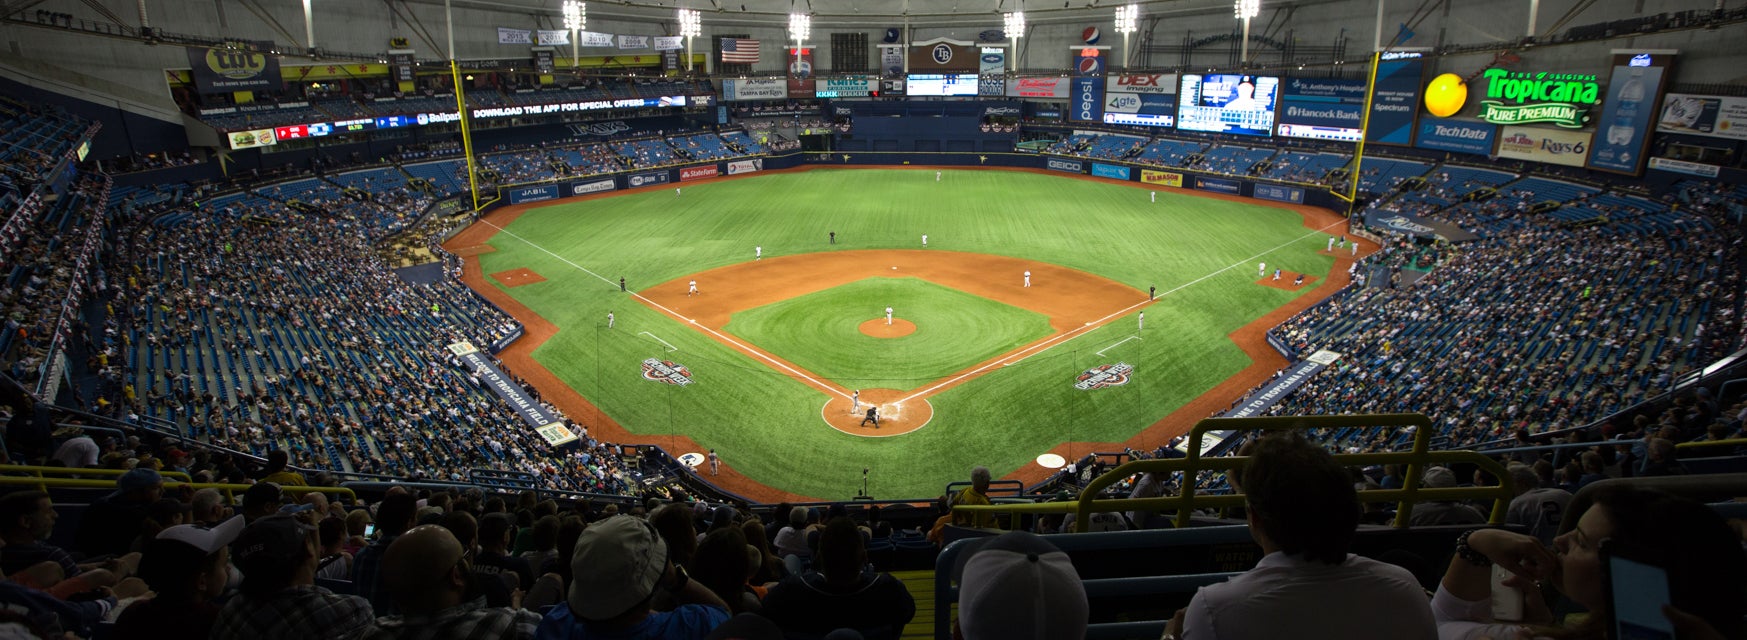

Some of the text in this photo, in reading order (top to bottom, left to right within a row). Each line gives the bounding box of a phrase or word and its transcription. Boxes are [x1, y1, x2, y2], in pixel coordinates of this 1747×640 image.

[1117, 74, 1162, 86] DEX
[1484, 68, 1599, 104] Tropicana
[1081, 80, 1094, 120] pepsi
[1120, 97, 1136, 106] gte
[474, 108, 522, 118] DOWNLOAD
[524, 106, 542, 114] THE
[543, 104, 560, 113] APP
[562, 103, 579, 111] FOR
[580, 101, 614, 110] SPECIAL
[614, 99, 644, 107] OFFERS
[1298, 108, 1360, 120] Hancock Bank
[1486, 107, 1576, 121] PURE PREMIUM
[1573, 142, 1584, 154] 6
[1049, 160, 1081, 170] GEICO
[466, 354, 548, 425] WELCOME TO TROPICANA FIELD
[1250, 362, 1319, 410] TO TROPICANA FIELD
[1216, 552, 1255, 562] WATCH
